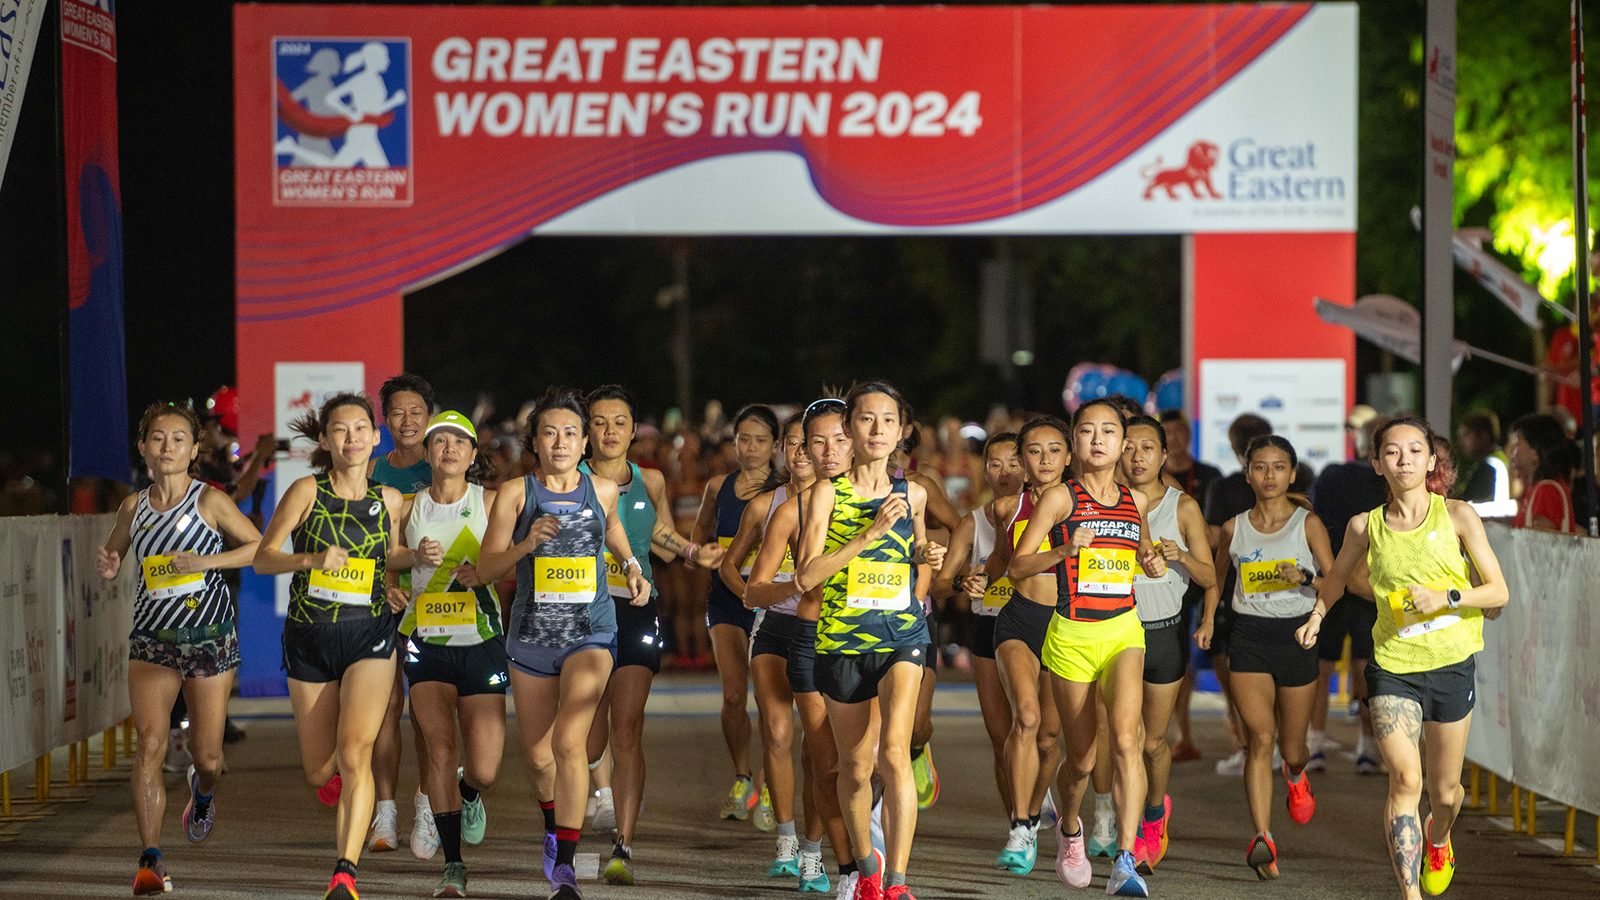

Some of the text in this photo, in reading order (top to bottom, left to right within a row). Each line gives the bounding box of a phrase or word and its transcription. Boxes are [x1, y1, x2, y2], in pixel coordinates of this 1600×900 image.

[432, 37, 883, 83] GREAT EASTERN
[434, 90, 983, 138] WOMEN'S RUN 2024
[1228, 137, 1317, 170] Great
[280, 170, 407, 185] GREAT EASTERN
[281, 185, 396, 200] WOMEN'S RUN
[1228, 172, 1346, 201] Eastern
[1093, 528, 1140, 541] UFFLERS
[149, 563, 175, 578] 280
[1088, 559, 1130, 571] 28008
[321, 567, 365, 581] 28001
[546, 568, 585, 580] 28011
[858, 573, 902, 586] 28023
[1248, 569, 1283, 583] 2802
[990, 585, 1014, 597] 280
[425, 602, 466, 615] 28017
